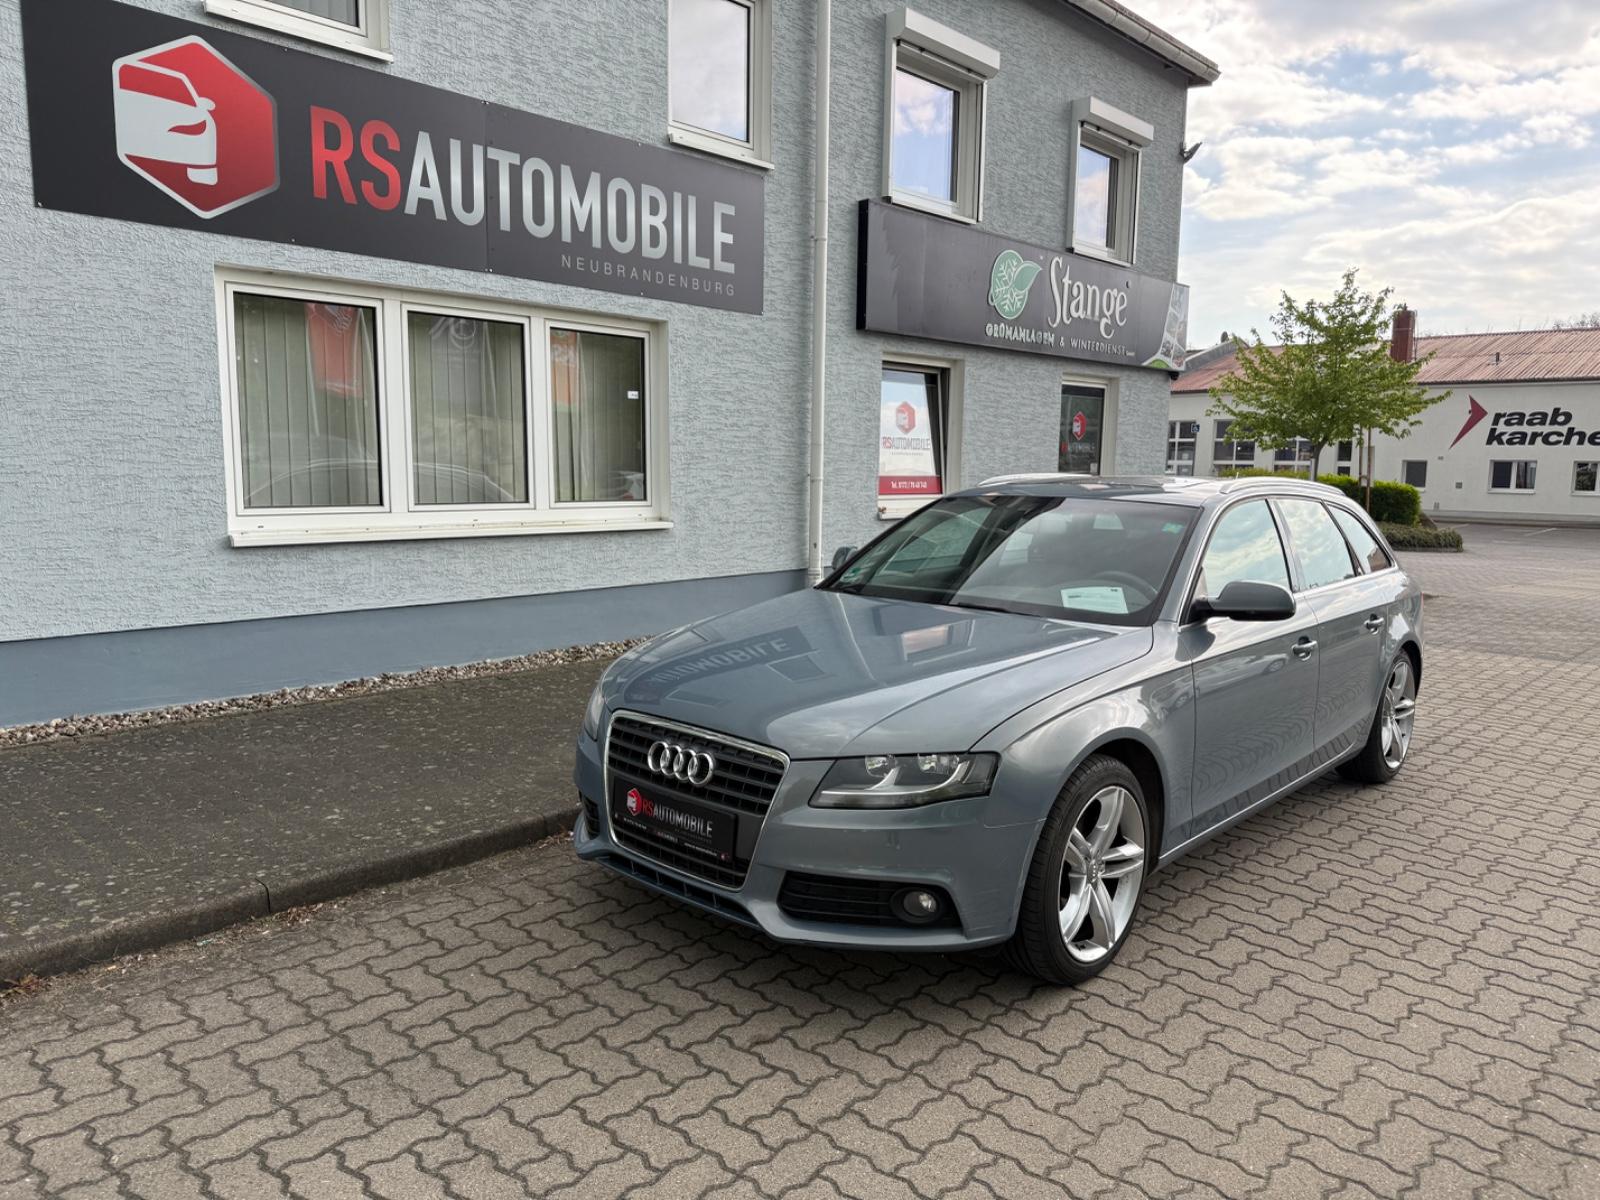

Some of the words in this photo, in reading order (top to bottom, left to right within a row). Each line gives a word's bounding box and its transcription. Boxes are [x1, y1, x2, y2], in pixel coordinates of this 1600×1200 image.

[561, 254, 736, 297] NEUBRANDENBURG
[1047, 256, 1128, 340] Stange
[1059, 336, 1066, 347] &
[1070, 338, 1127, 357] WINTERDIENST
[1491, 407, 1573, 427] raab
[642, 798, 714, 839] RSAUTOMOBILE
